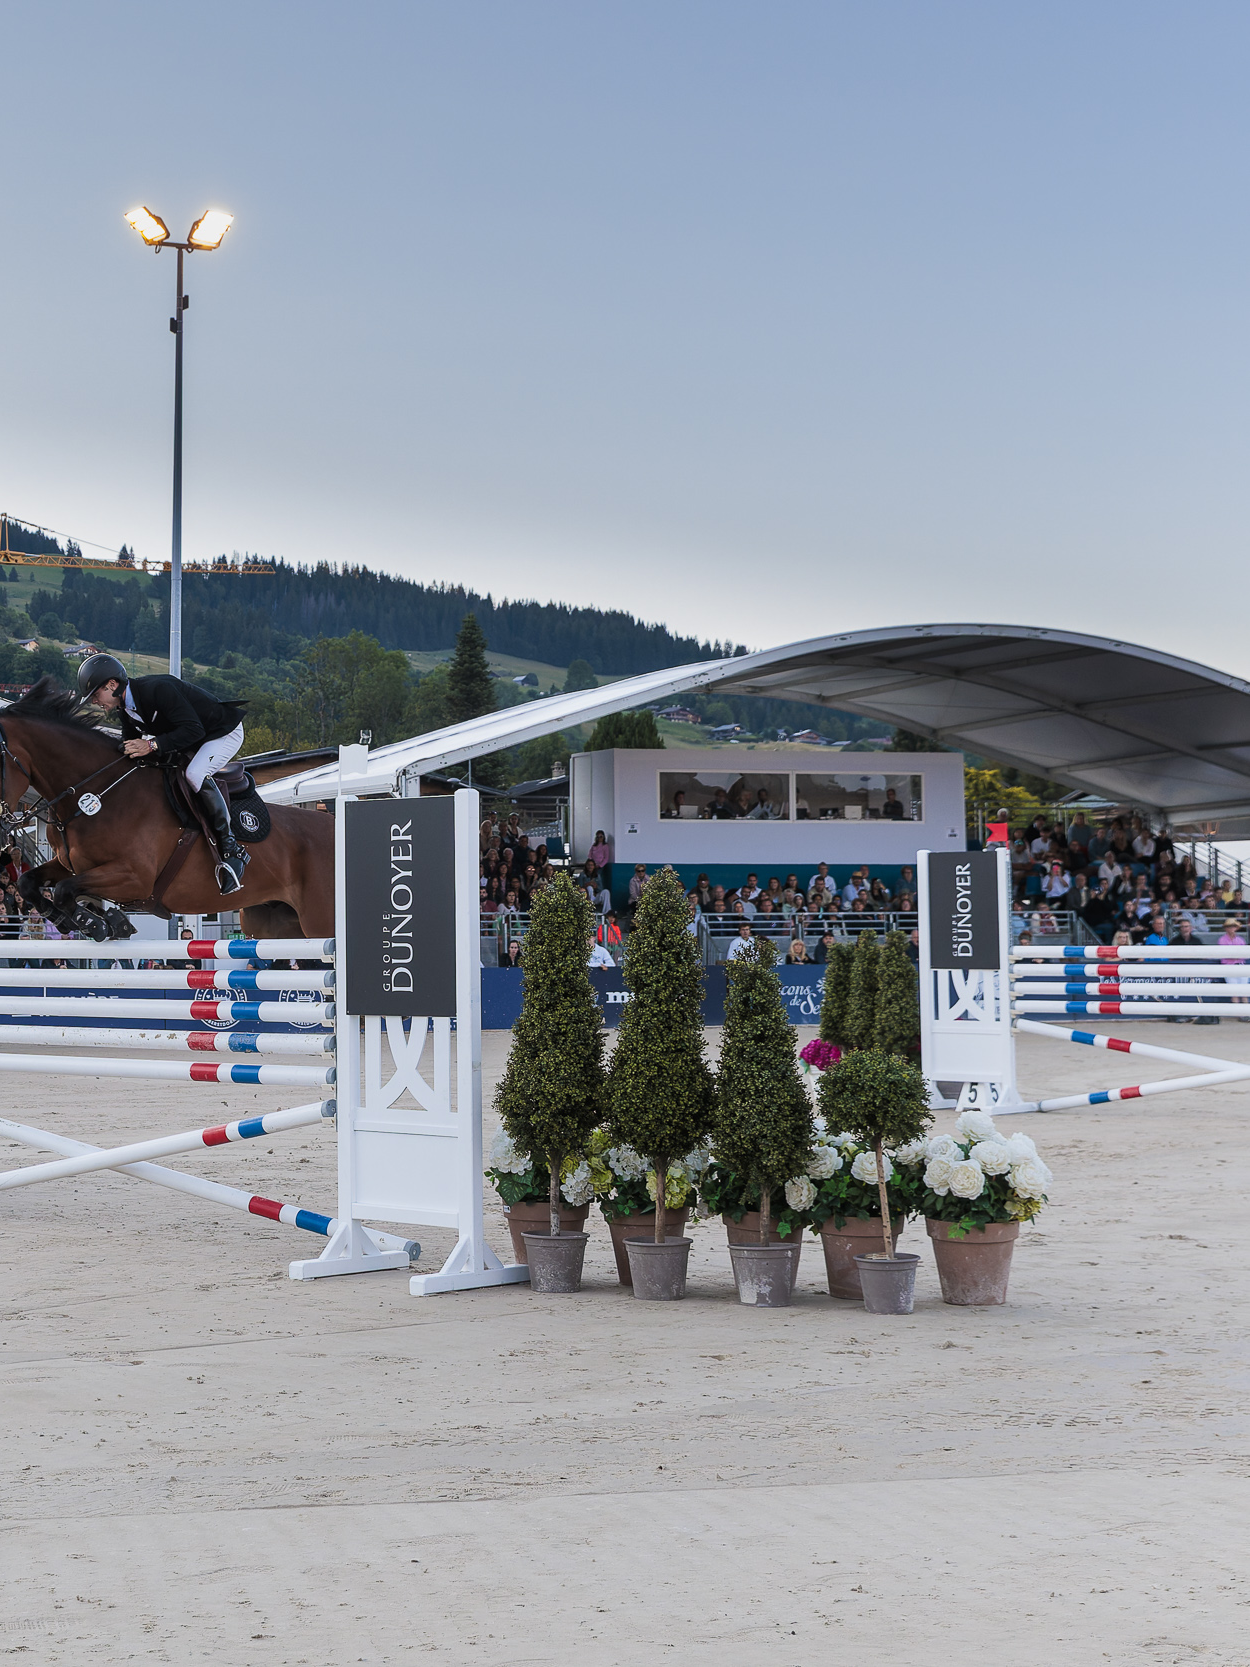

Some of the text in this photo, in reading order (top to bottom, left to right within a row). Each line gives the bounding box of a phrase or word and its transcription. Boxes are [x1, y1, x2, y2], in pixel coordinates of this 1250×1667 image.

[391, 819, 414, 993] DUNOYER
[955, 862, 973, 958] DUNOYER
[382, 912, 391, 992] GROUPE
[789, 995, 802, 1006] de
[800, 993, 821, 1015] Se
[967, 1082, 979, 1104] 5
[989, 1082, 999, 1103] 5
